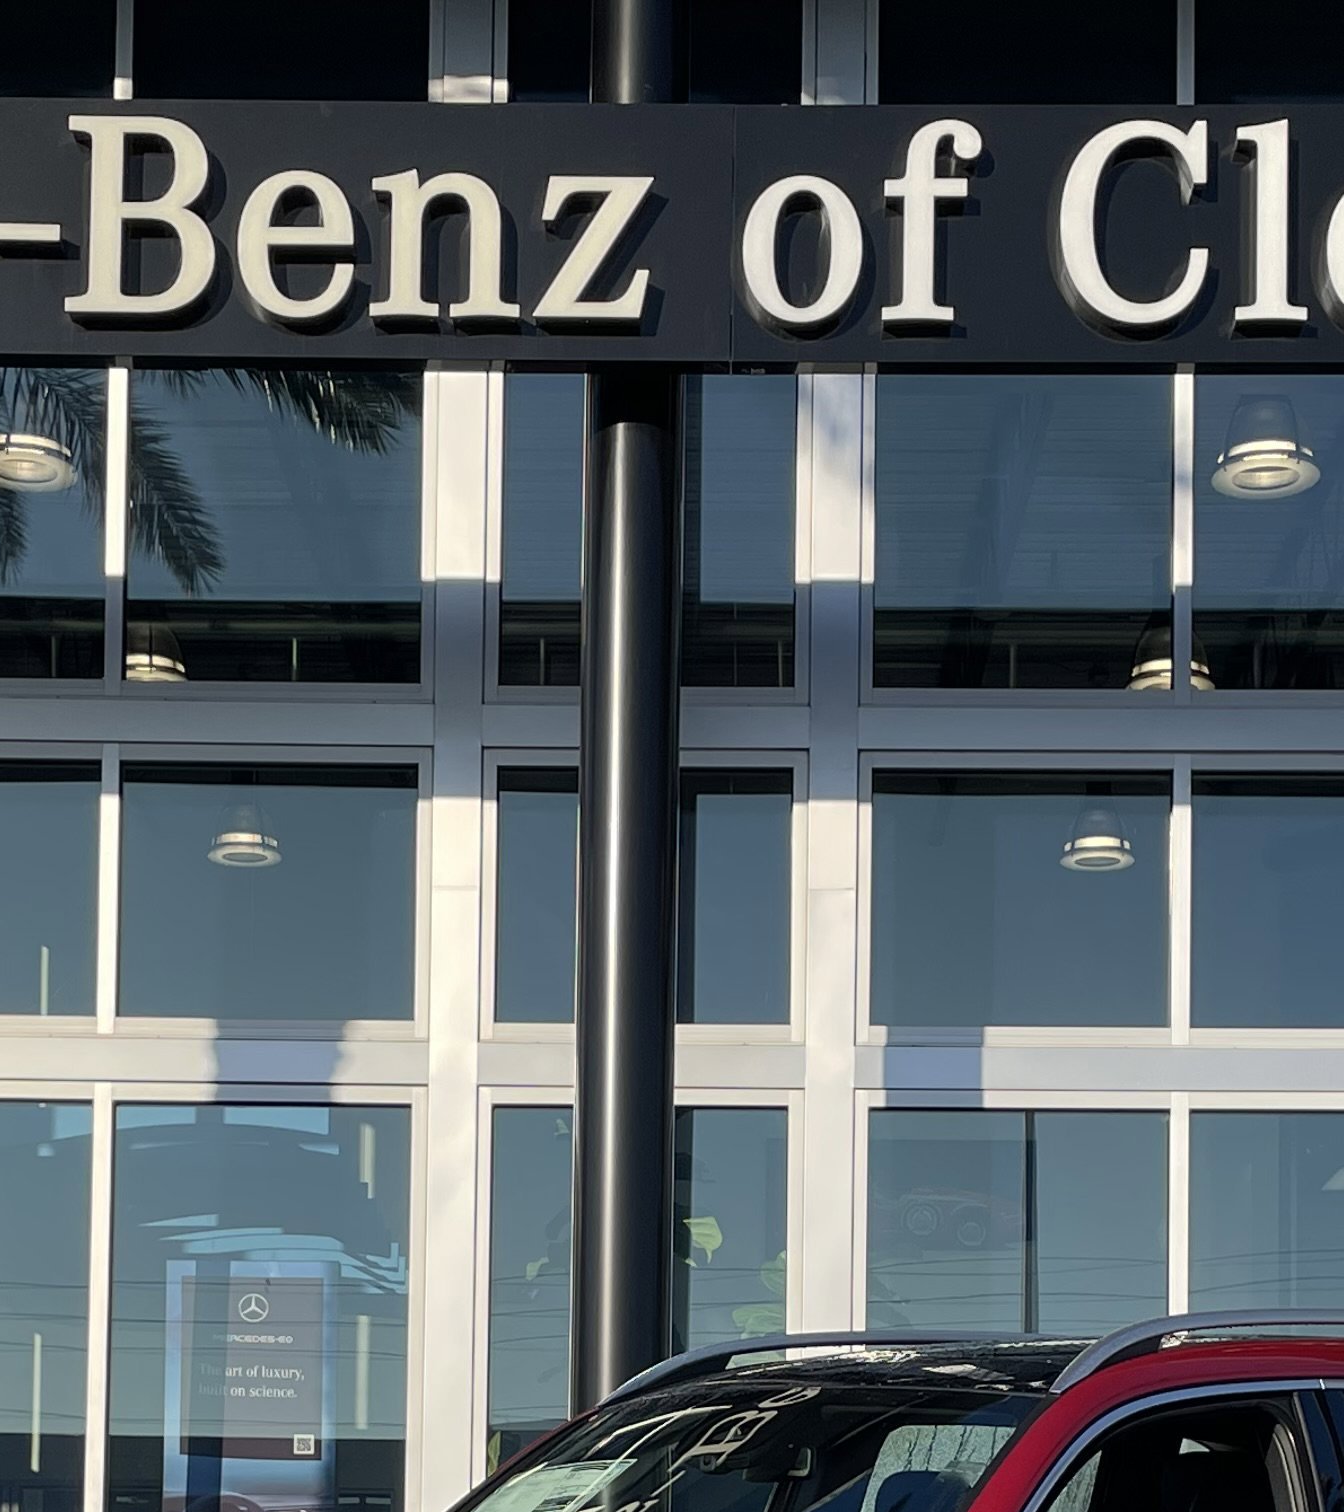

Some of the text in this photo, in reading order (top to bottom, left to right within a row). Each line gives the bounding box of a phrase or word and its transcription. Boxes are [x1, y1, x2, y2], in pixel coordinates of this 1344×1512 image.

[739, 117, 984, 327] of
[225, 1365, 243, 1377] art
[246, 1364, 260, 1378] of
[261, 1364, 305, 1382] luxury,
[230, 1386, 245, 1397] on
[248, 1385, 298, 1398] science.
